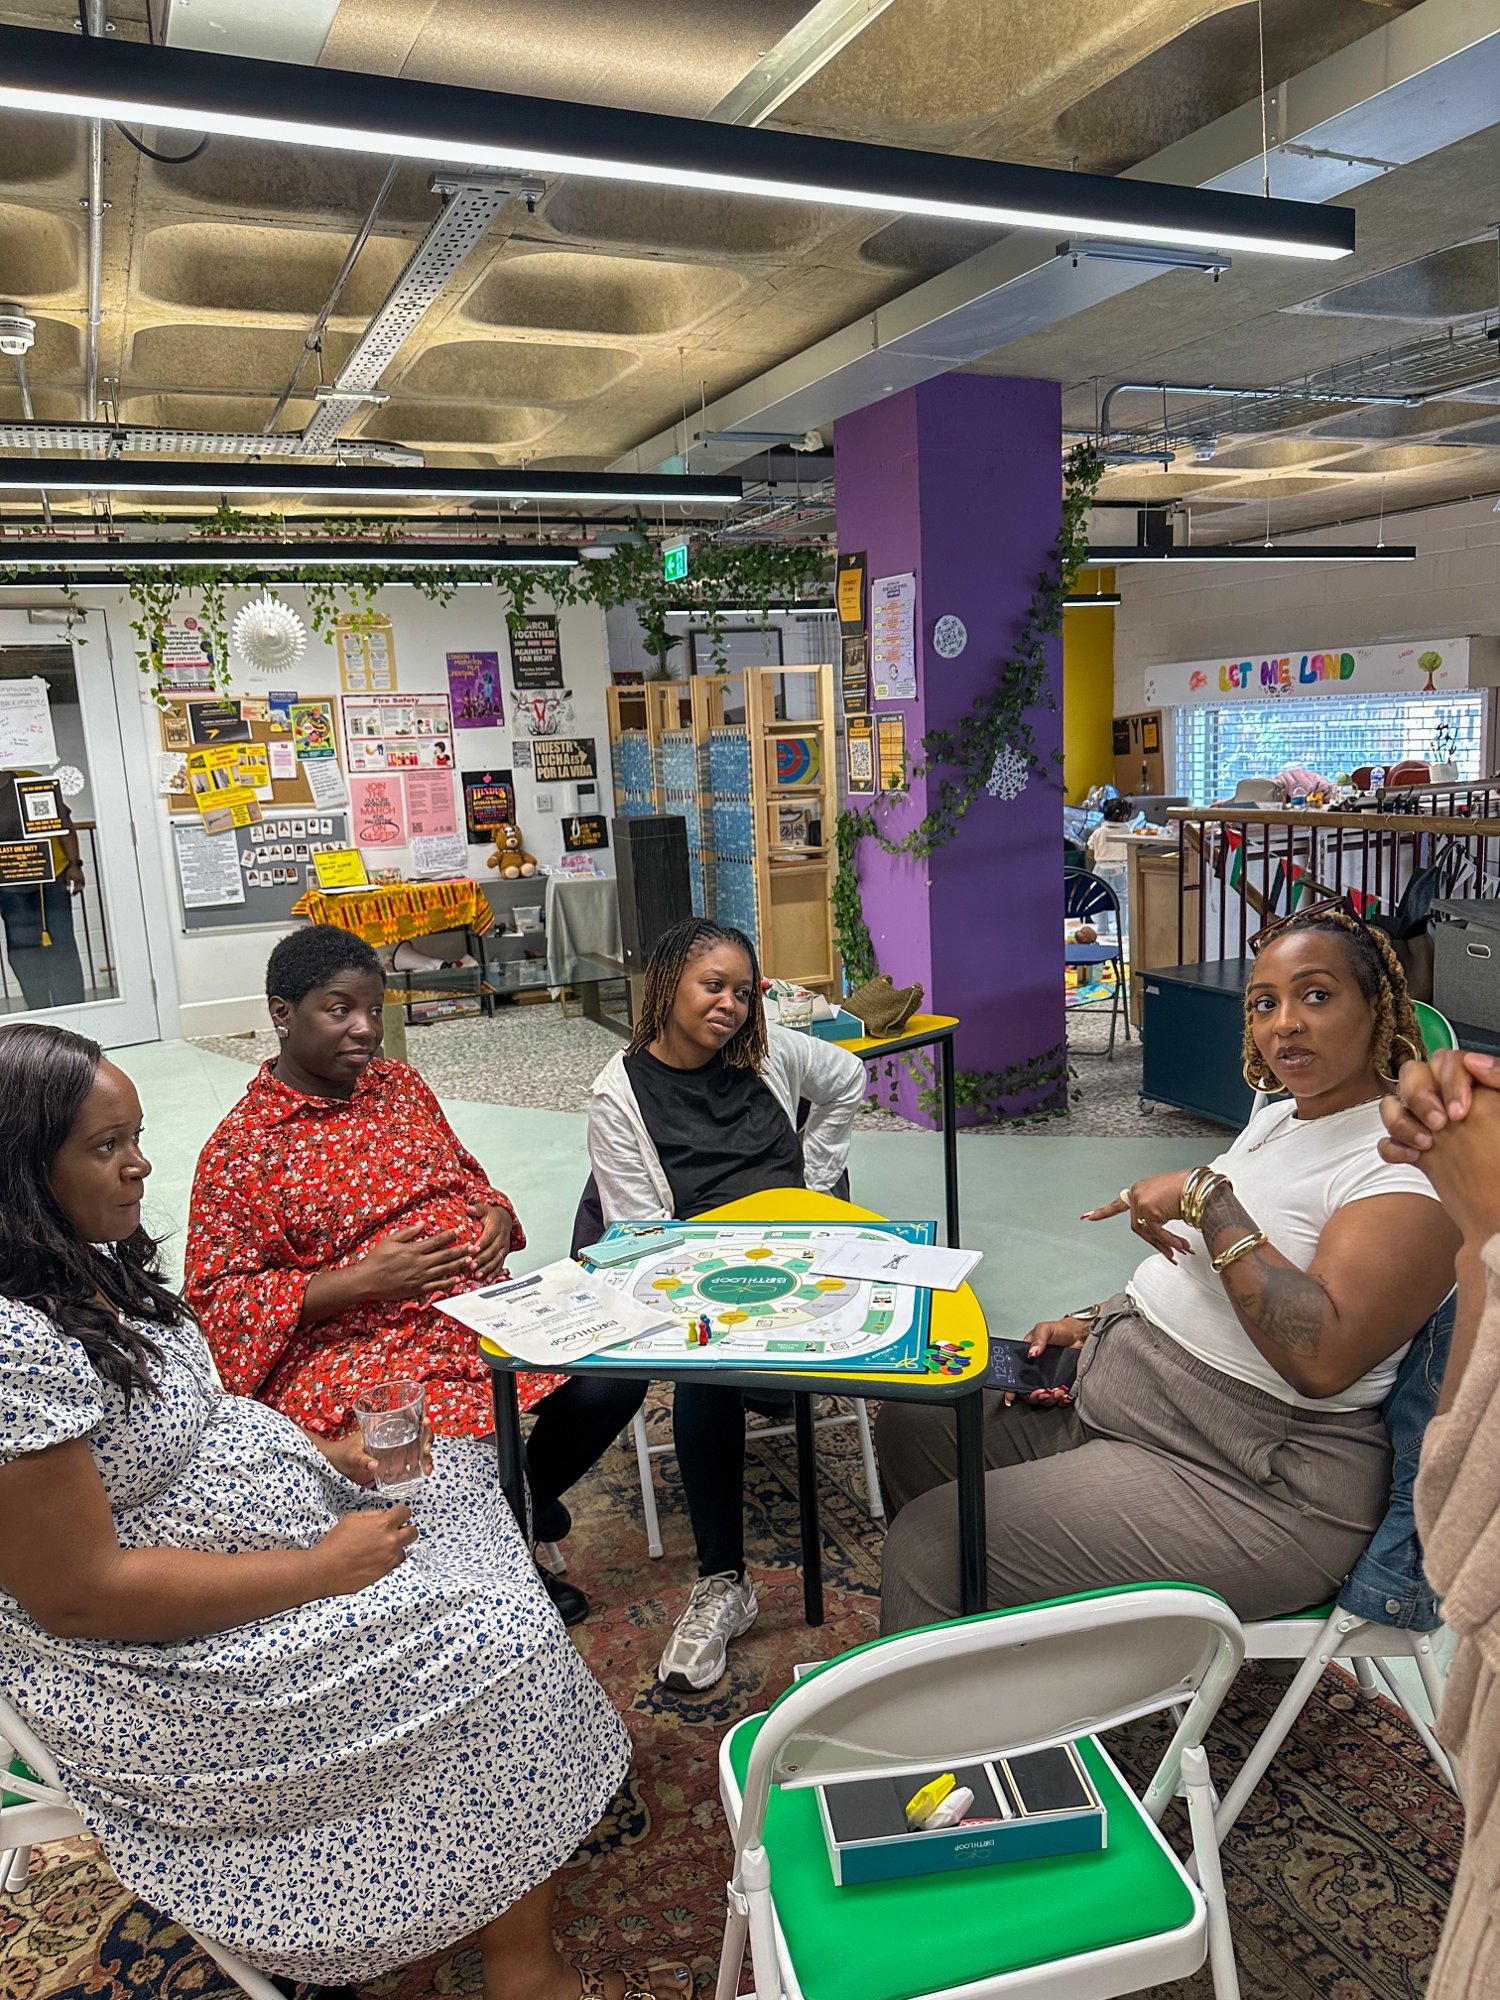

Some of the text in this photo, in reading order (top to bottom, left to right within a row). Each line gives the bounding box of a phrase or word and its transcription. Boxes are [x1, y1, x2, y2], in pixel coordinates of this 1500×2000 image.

[514, 630, 556, 639] TOGETHER
[1219, 652, 1355, 692] LET ME LAND
[536, 753, 570, 766] LUCHA
[570, 755, 580, 764] ES
[537, 764, 593, 779] POR LA VIDA
[366, 782, 386, 792] JOIN
[473, 787, 506, 800] HINDUS
[361, 806, 395, 815] MARCH
[372, 824, 386, 832] ON
[550, 1320, 618, 1346] BIRTHLOOP
[993, 1346, 1006, 1379] 12:09
